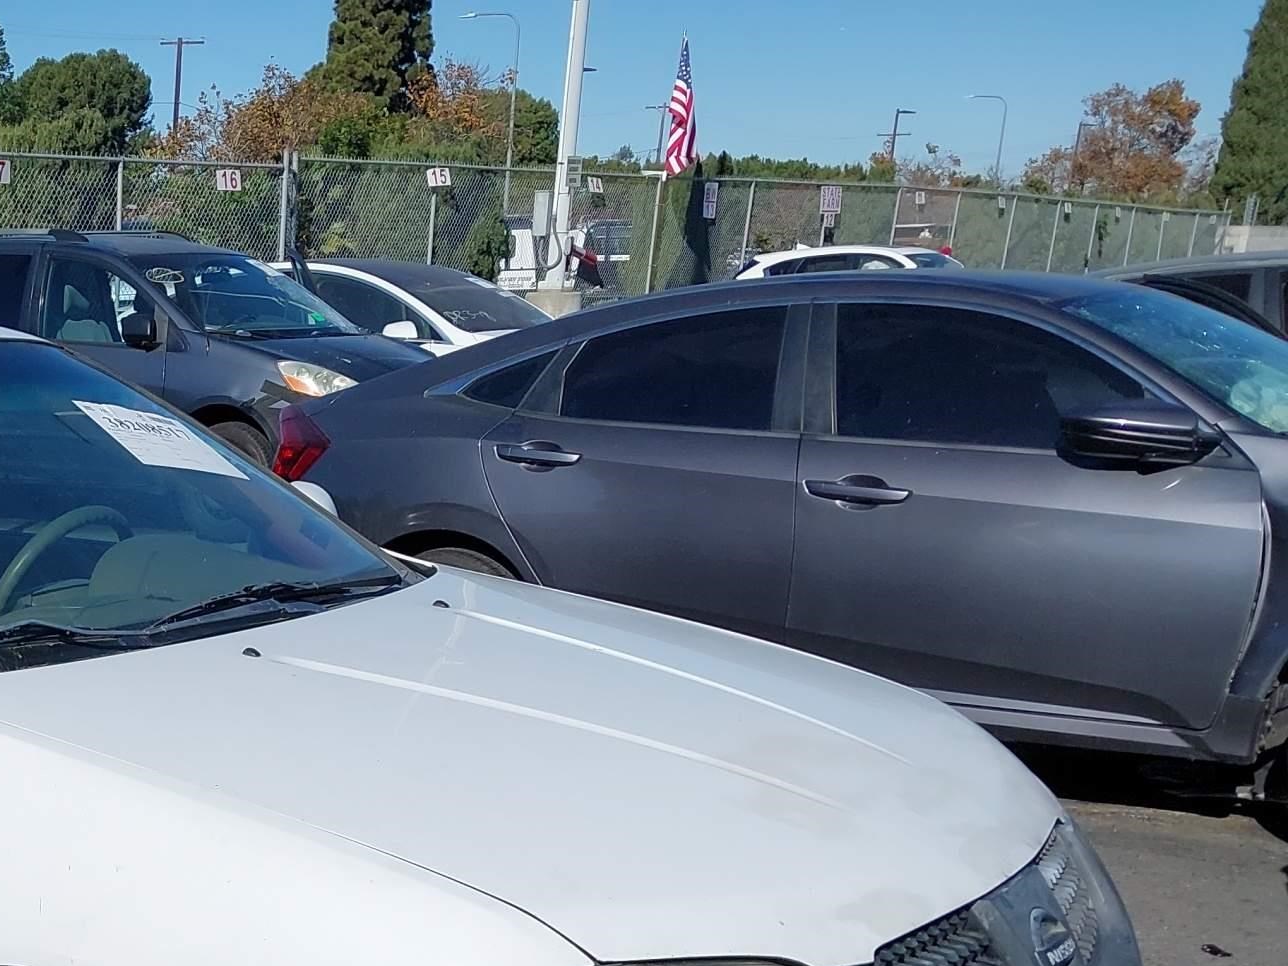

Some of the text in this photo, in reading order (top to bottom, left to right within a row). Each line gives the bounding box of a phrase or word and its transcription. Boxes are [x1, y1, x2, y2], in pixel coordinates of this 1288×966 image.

[221, 170, 238, 189] 16
[431, 168, 448, 184] 15
[590, 178, 601, 192] 14
[822, 187, 840, 198] STATE
[825, 214, 834, 226] 12
[101, 415, 193, 441] 38208517
